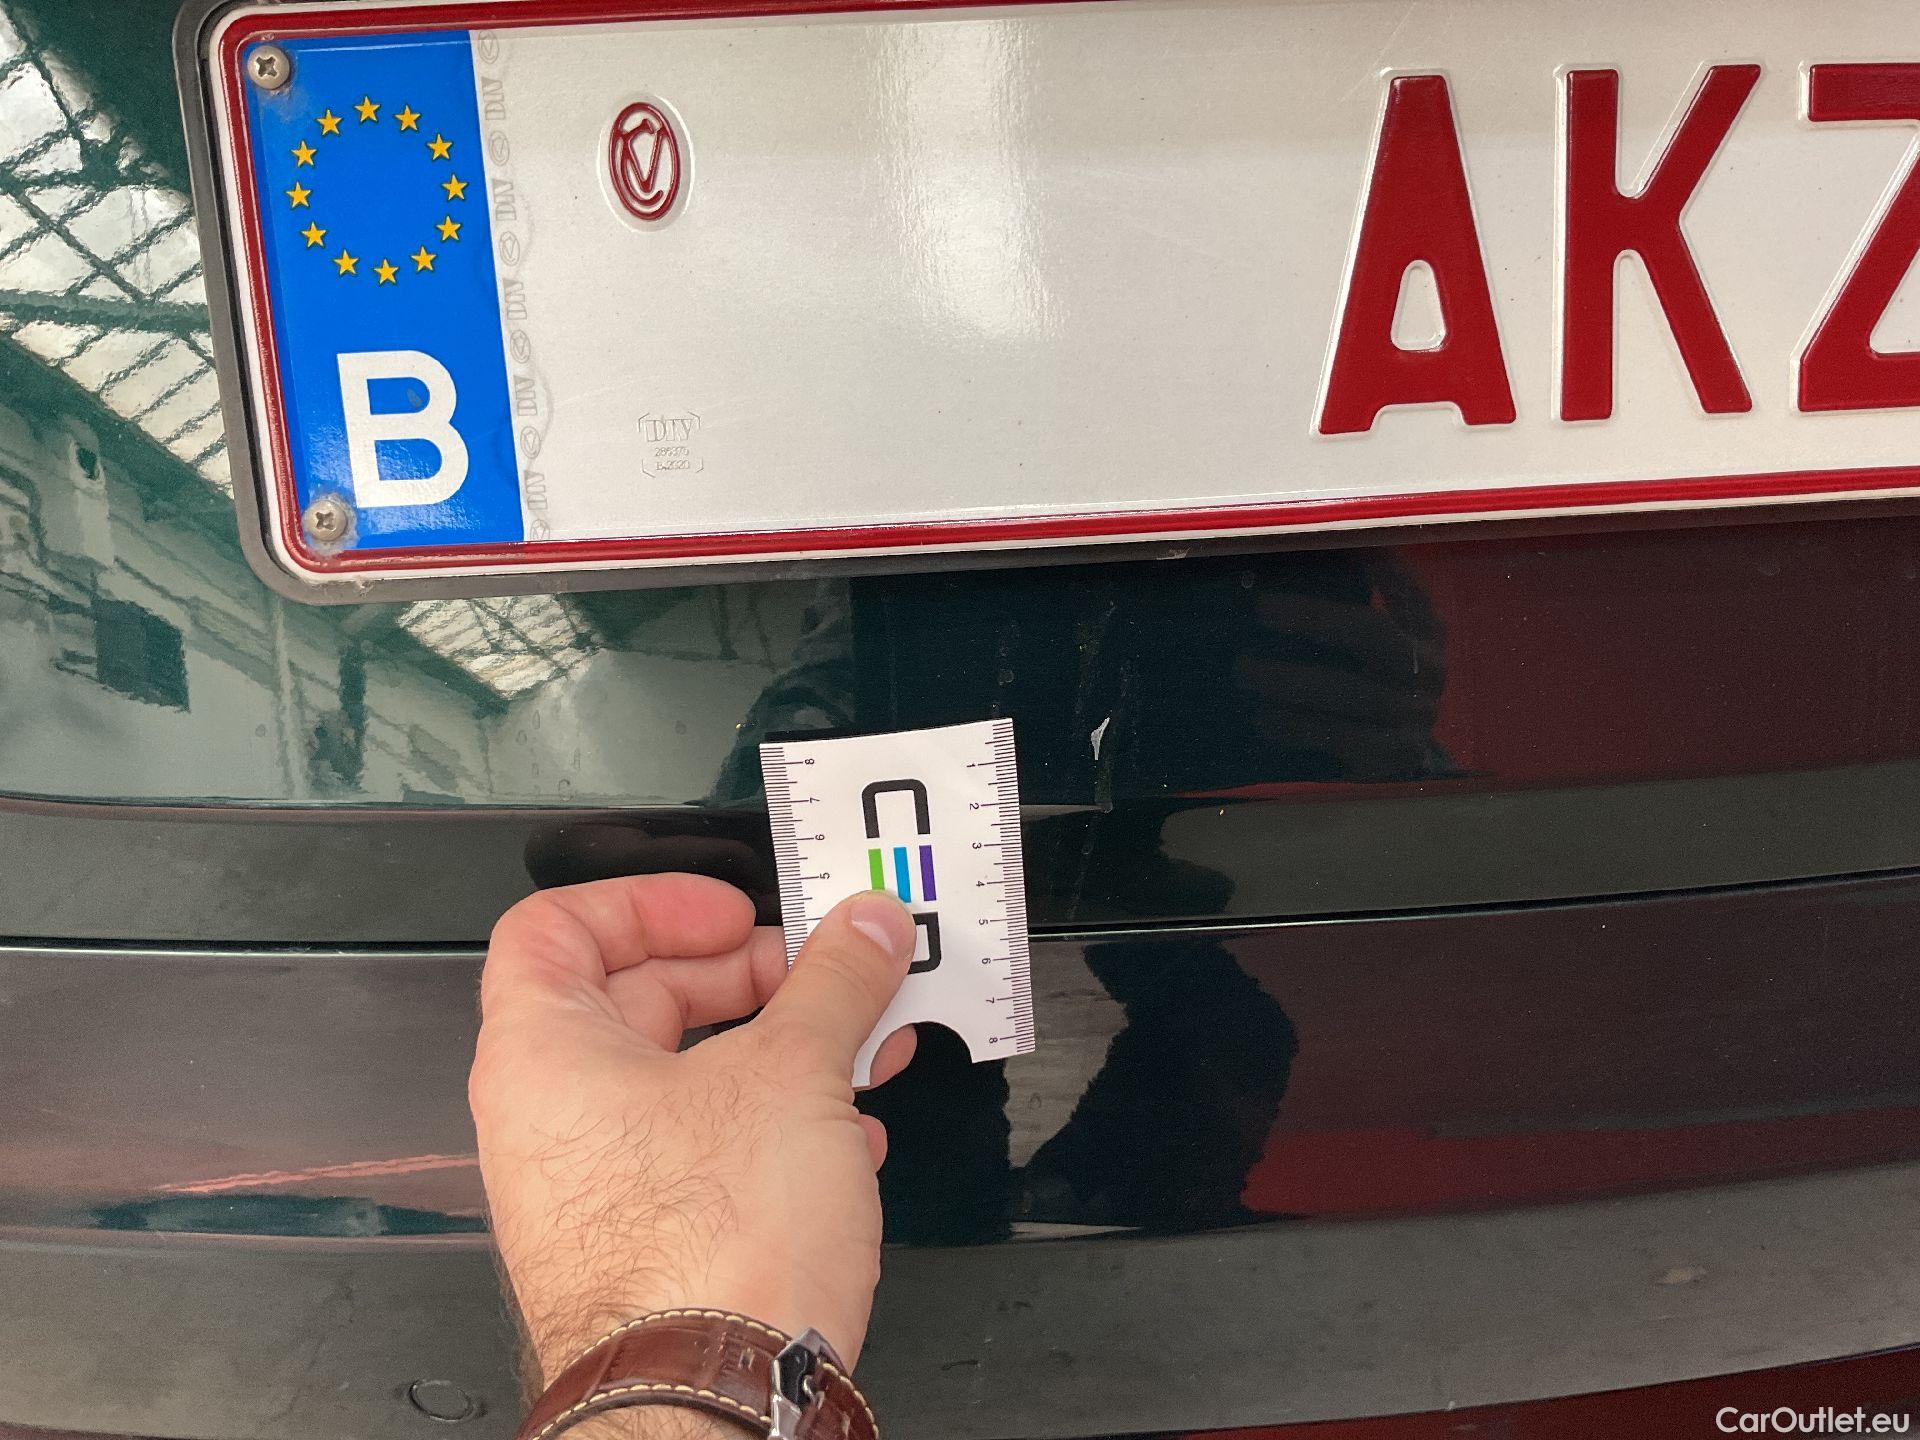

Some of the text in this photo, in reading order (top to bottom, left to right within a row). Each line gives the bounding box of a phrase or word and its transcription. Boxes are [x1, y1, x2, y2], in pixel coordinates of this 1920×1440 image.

[337, 350, 469, 508] B
[970, 802, 979, 810] 2
[972, 842, 982, 850] 3
[979, 918, 989, 926] 5
[982, 957, 991, 965] 6
